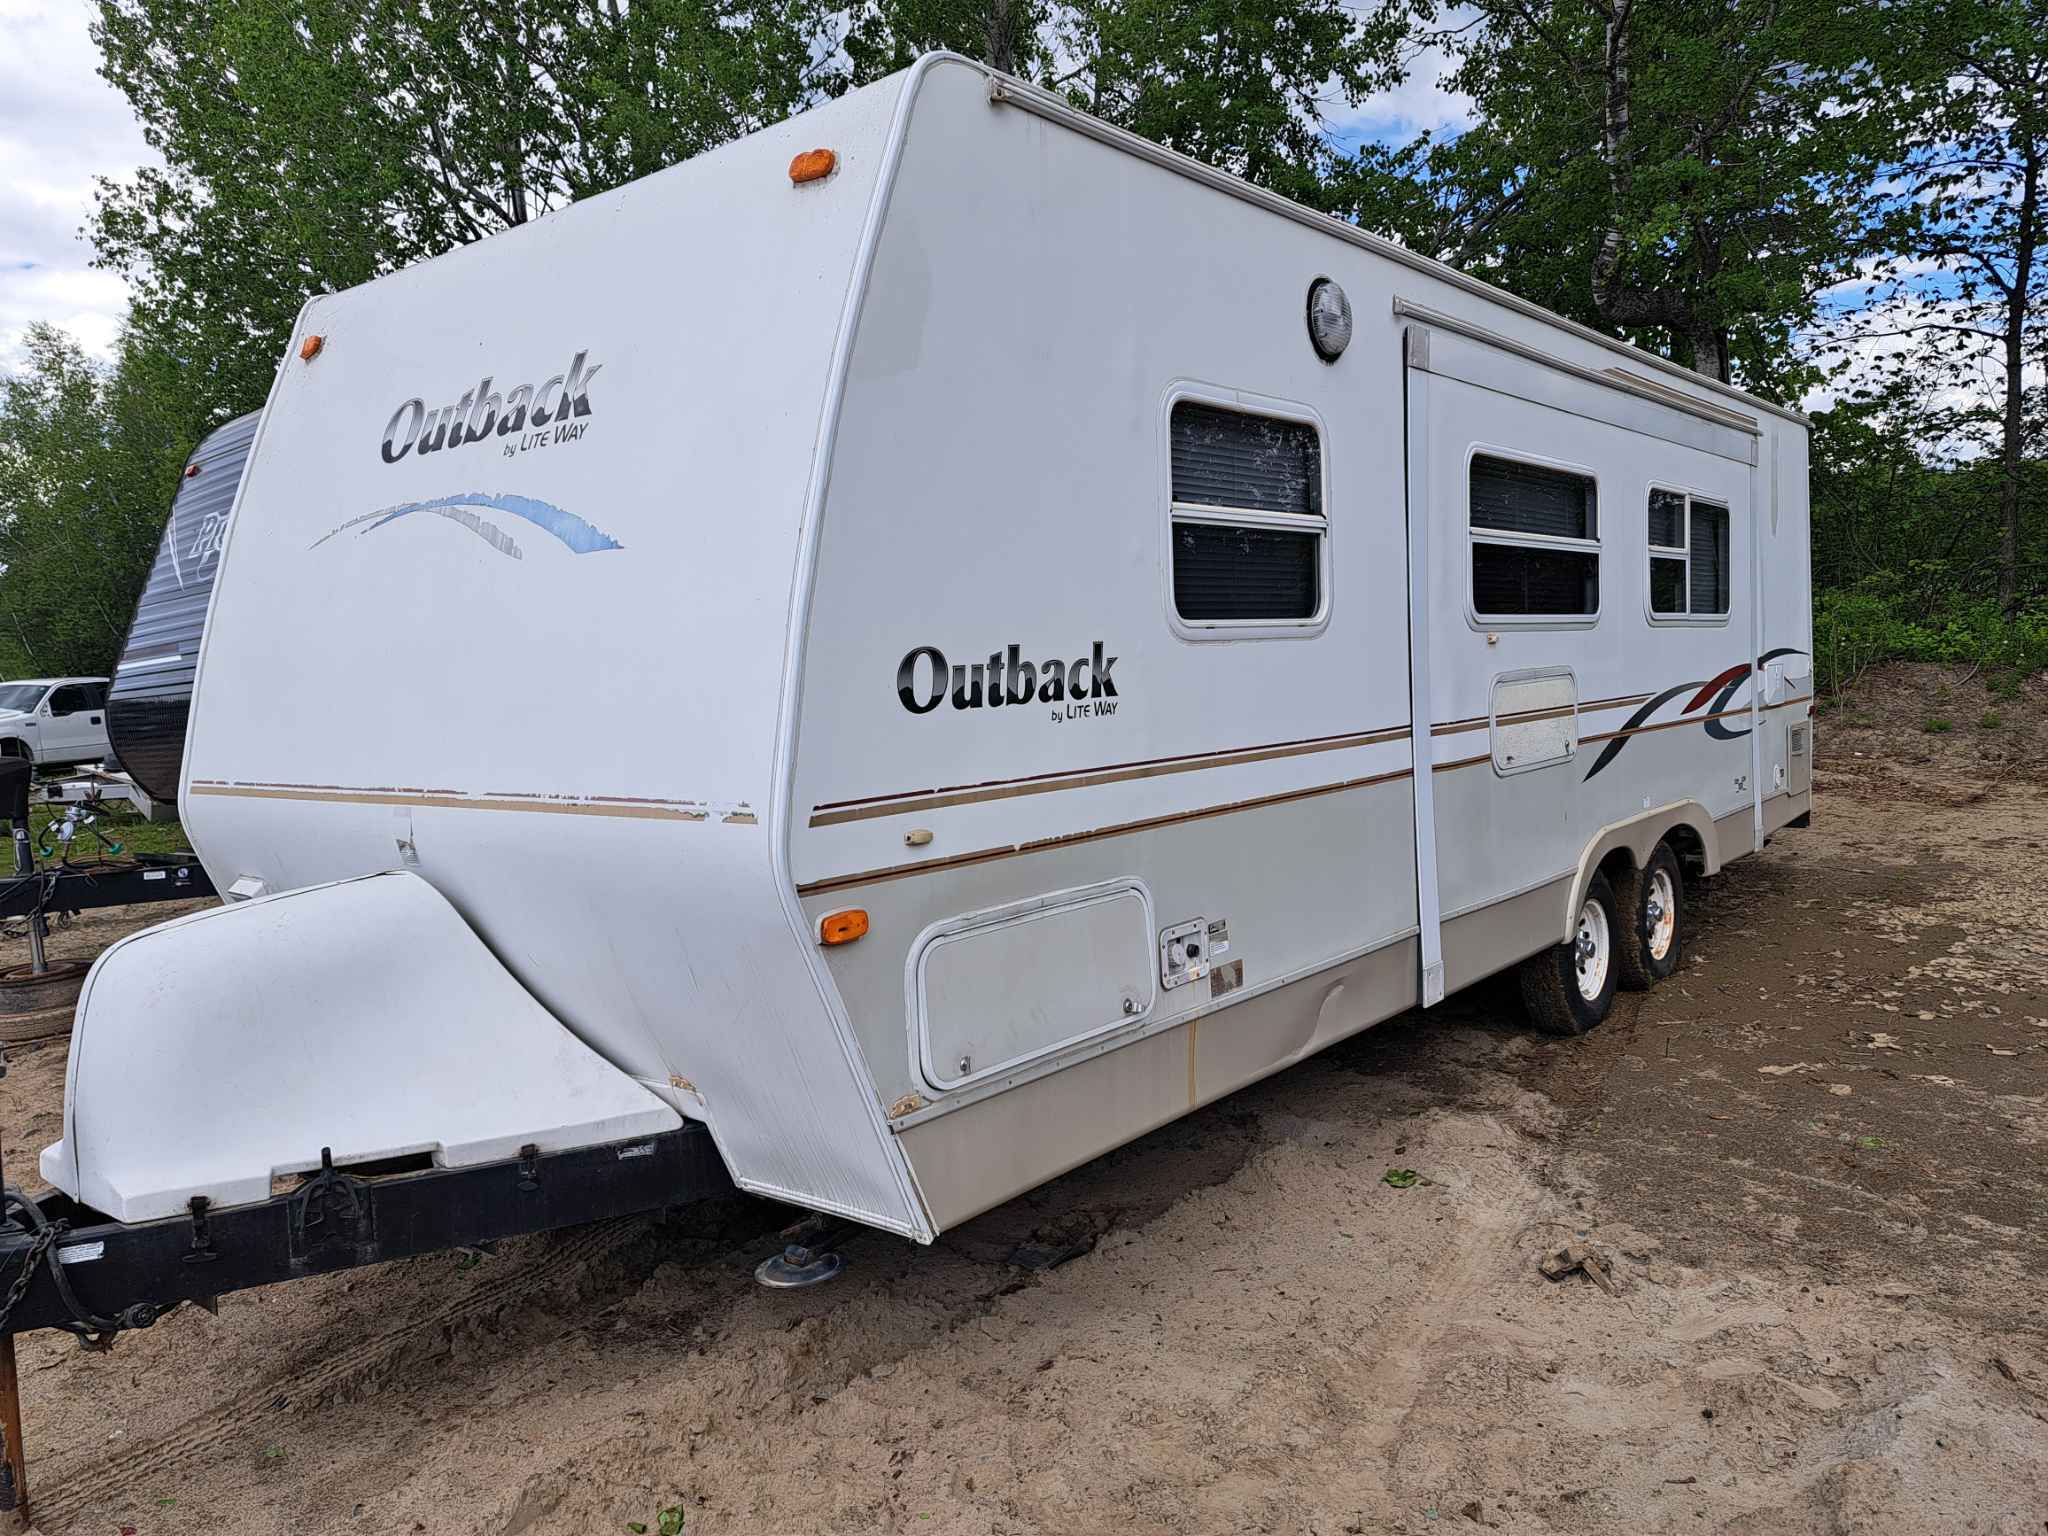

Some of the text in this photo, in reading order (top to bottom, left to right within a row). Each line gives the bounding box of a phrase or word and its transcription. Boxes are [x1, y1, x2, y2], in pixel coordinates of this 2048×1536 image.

[381, 349, 602, 464] Outback
[503, 423, 589, 457] by LITE WAY
[896, 640, 1119, 714] Outback
[1051, 701, 1118, 724] by LITE WAY
